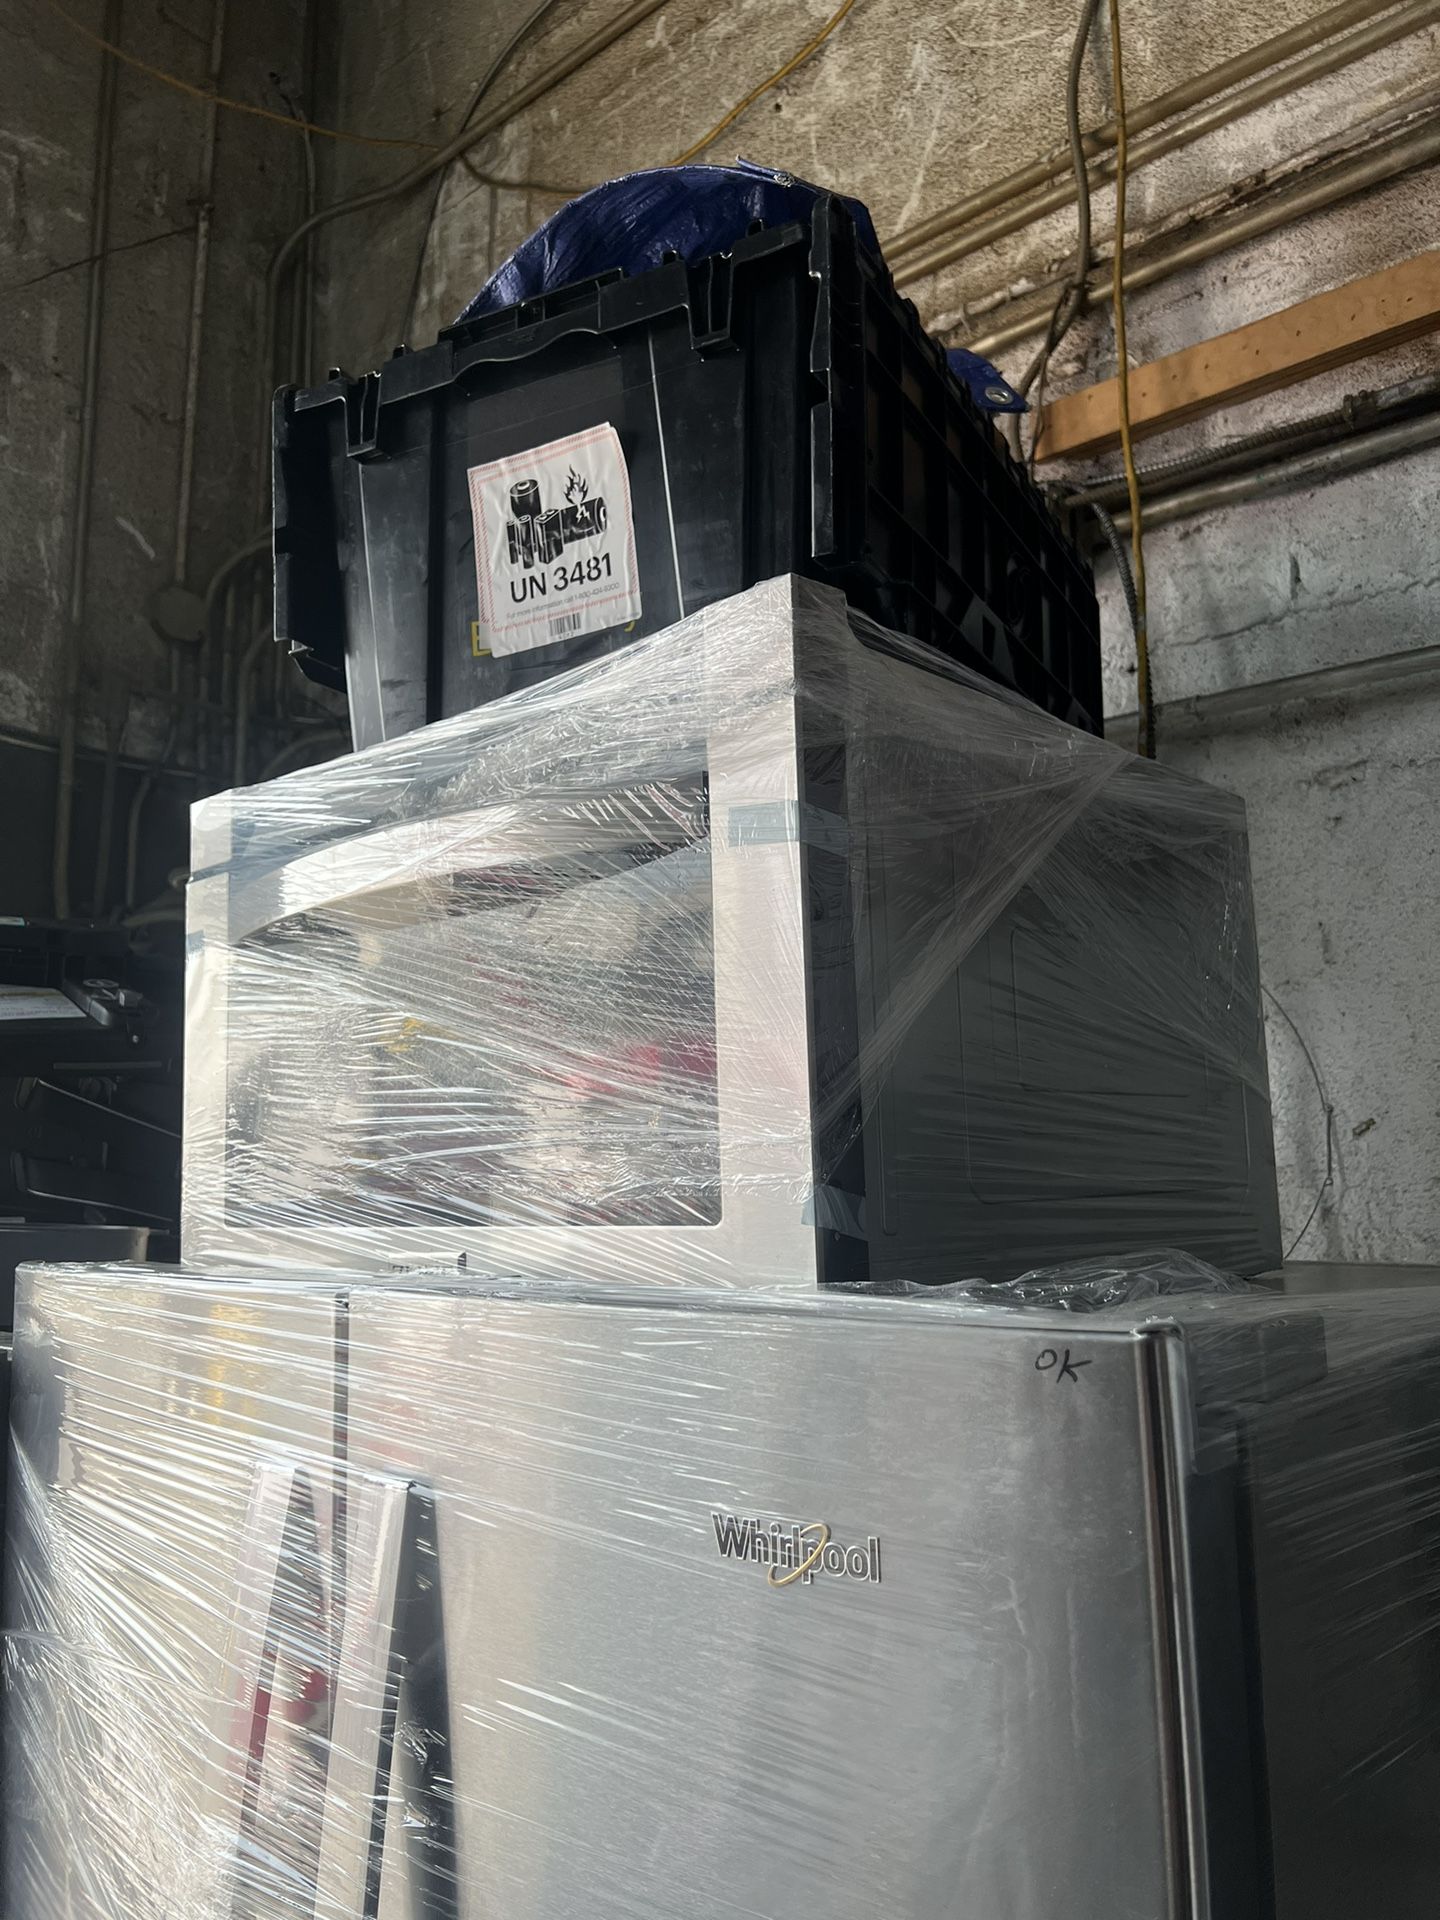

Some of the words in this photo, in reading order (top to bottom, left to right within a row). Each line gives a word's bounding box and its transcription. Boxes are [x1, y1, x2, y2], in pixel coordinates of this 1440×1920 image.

[511, 573, 547, 603] UN
[553, 553, 612, 591] 3481
[1035, 1349, 1093, 1383] OK
[710, 1511, 882, 1586] Whirlpool
